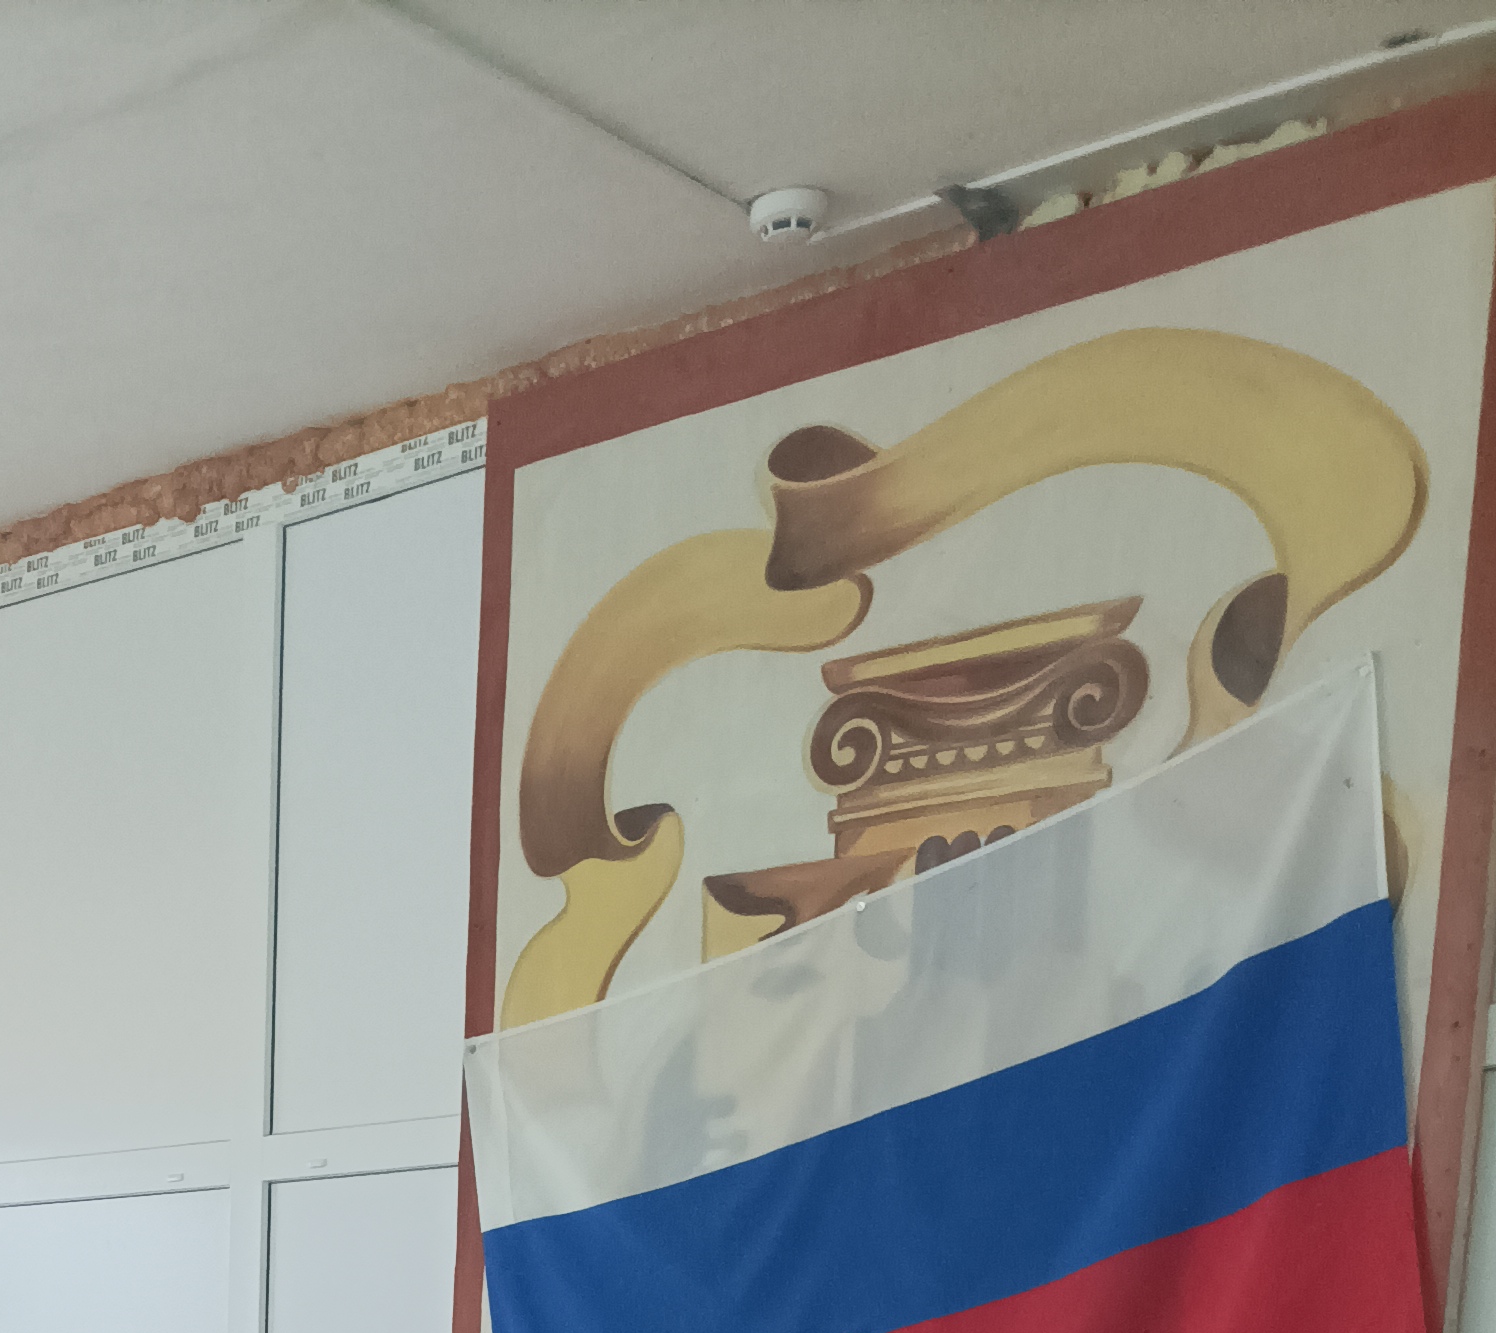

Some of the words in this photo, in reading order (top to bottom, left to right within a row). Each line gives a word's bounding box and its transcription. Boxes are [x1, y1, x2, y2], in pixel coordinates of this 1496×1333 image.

[0, 577, 23, 593] BLITZ
[37, 573, 59, 590] BLITZ
[94, 549, 118, 567] BLITZ
[132, 545, 157, 562] BLITZ
[194, 519, 219, 538] BLITZ
[235, 515, 261, 533] BLITZ
[300, 488, 327, 508] BLITZ
[344, 481, 371, 500] BLITZ
[414, 451, 442, 471] BLITZ
[461, 444, 486, 464] BLIT
[27, 556, 49, 573] BLITZ
[121, 528, 146, 545] BLITZ
[223, 497, 249, 516] BLITZ
[331, 462, 359, 483] BLITZ
[448, 423, 477, 446] BLITZ
